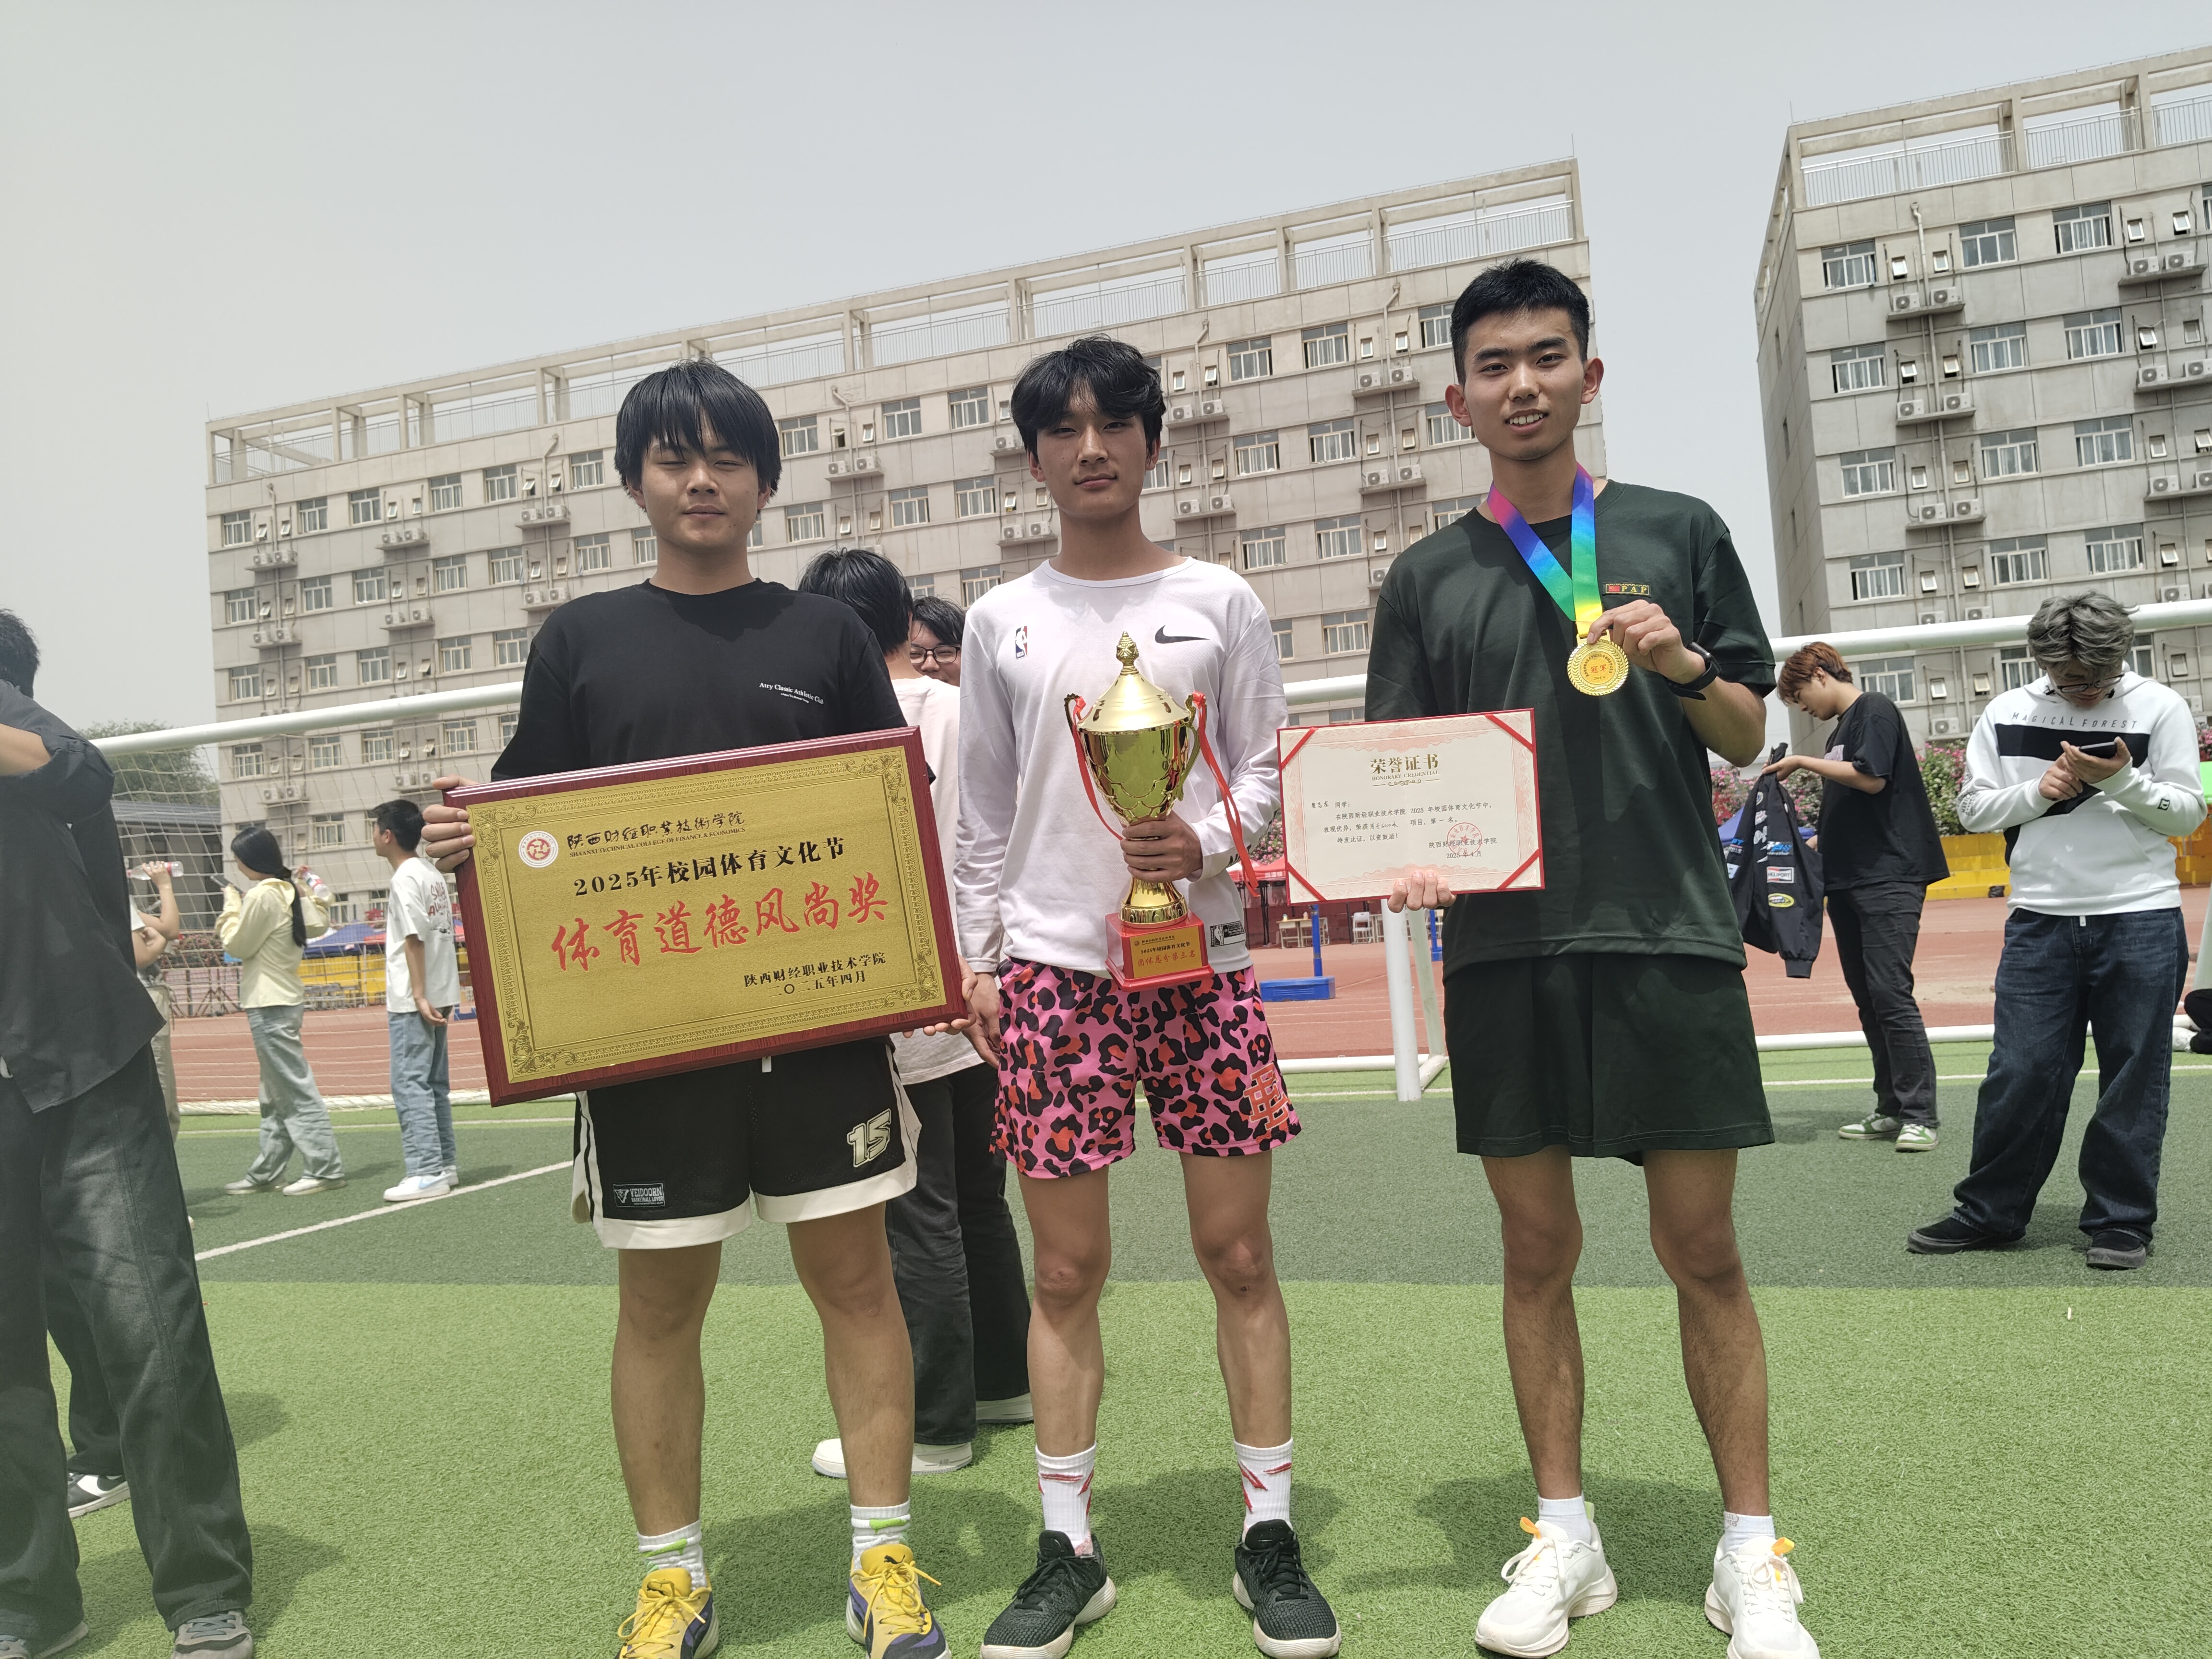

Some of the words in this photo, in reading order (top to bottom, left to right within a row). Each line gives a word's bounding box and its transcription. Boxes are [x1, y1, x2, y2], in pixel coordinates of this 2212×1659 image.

[774, 684, 793, 693] Classic
[794, 688, 814, 700] Athletic
[815, 696, 824, 704] Club
[2012, 712, 2074, 726] MAGICAL
[2082, 719, 2137, 729] FOREST
[1370, 754, 1438, 774] 荣誉证书
[569, 848, 598, 858] SHAANXI
[600, 843, 635, 855] TECHNICAL
[636, 838, 666, 848] COLLEGE
[675, 833, 702, 842] FINANCE
[709, 827, 745, 838] ECONOMICS
[1429, 837, 1497, 849] 陕西财经职业技术学院
[573, 837, 845, 896] 2025年校园体育文化节
[551, 871, 889, 972] 体育道德风尚奖
[1141, 941, 1190, 954] 2025年校园体育文化节
[1138, 950, 1196, 966] 团体总分第三名
[744, 951, 887, 987] 陕西财经职业技术学院
[847, 1108, 891, 1167] 15
